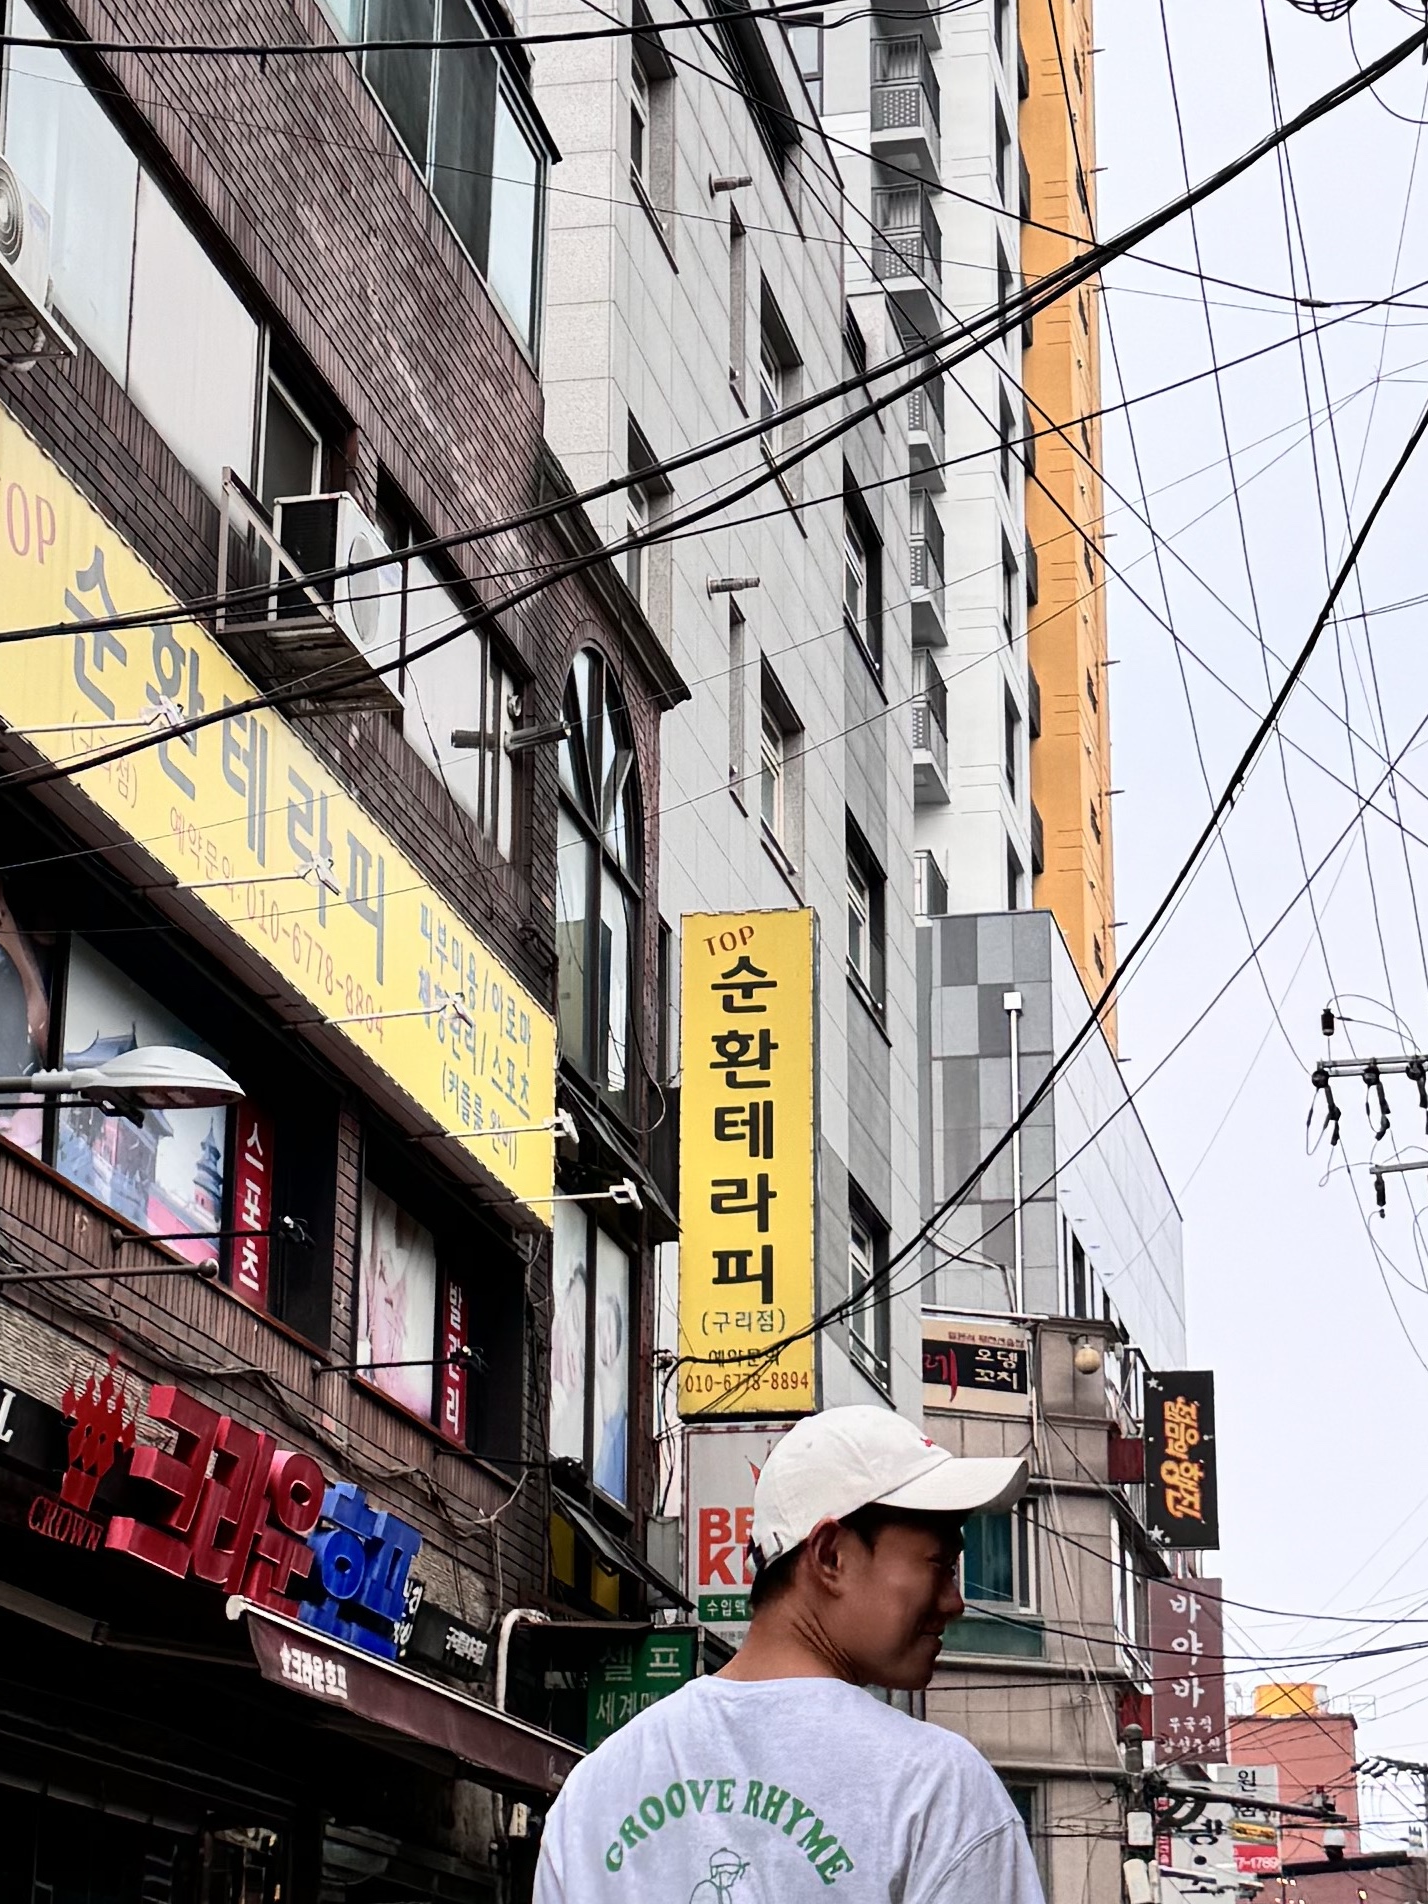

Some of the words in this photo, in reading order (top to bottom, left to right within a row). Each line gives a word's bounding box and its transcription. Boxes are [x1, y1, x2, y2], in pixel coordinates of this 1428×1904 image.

[63, 545, 386, 987] 순환테라피
[703, 925, 756, 959] TOP
[708, 955, 779, 1305] 순환테라피
[238, 1122, 265, 1293] 스포츠
[701, 1307, 786, 1336] (구리점)
[973, 1367, 1019, 1391] 꼬치
[974, 1348, 1019, 1369] 오뎅
[27, 1495, 105, 1551] CROWN
[605, 1778, 737, 1873] GROOVE
[740, 1779, 855, 1886] RHYME
